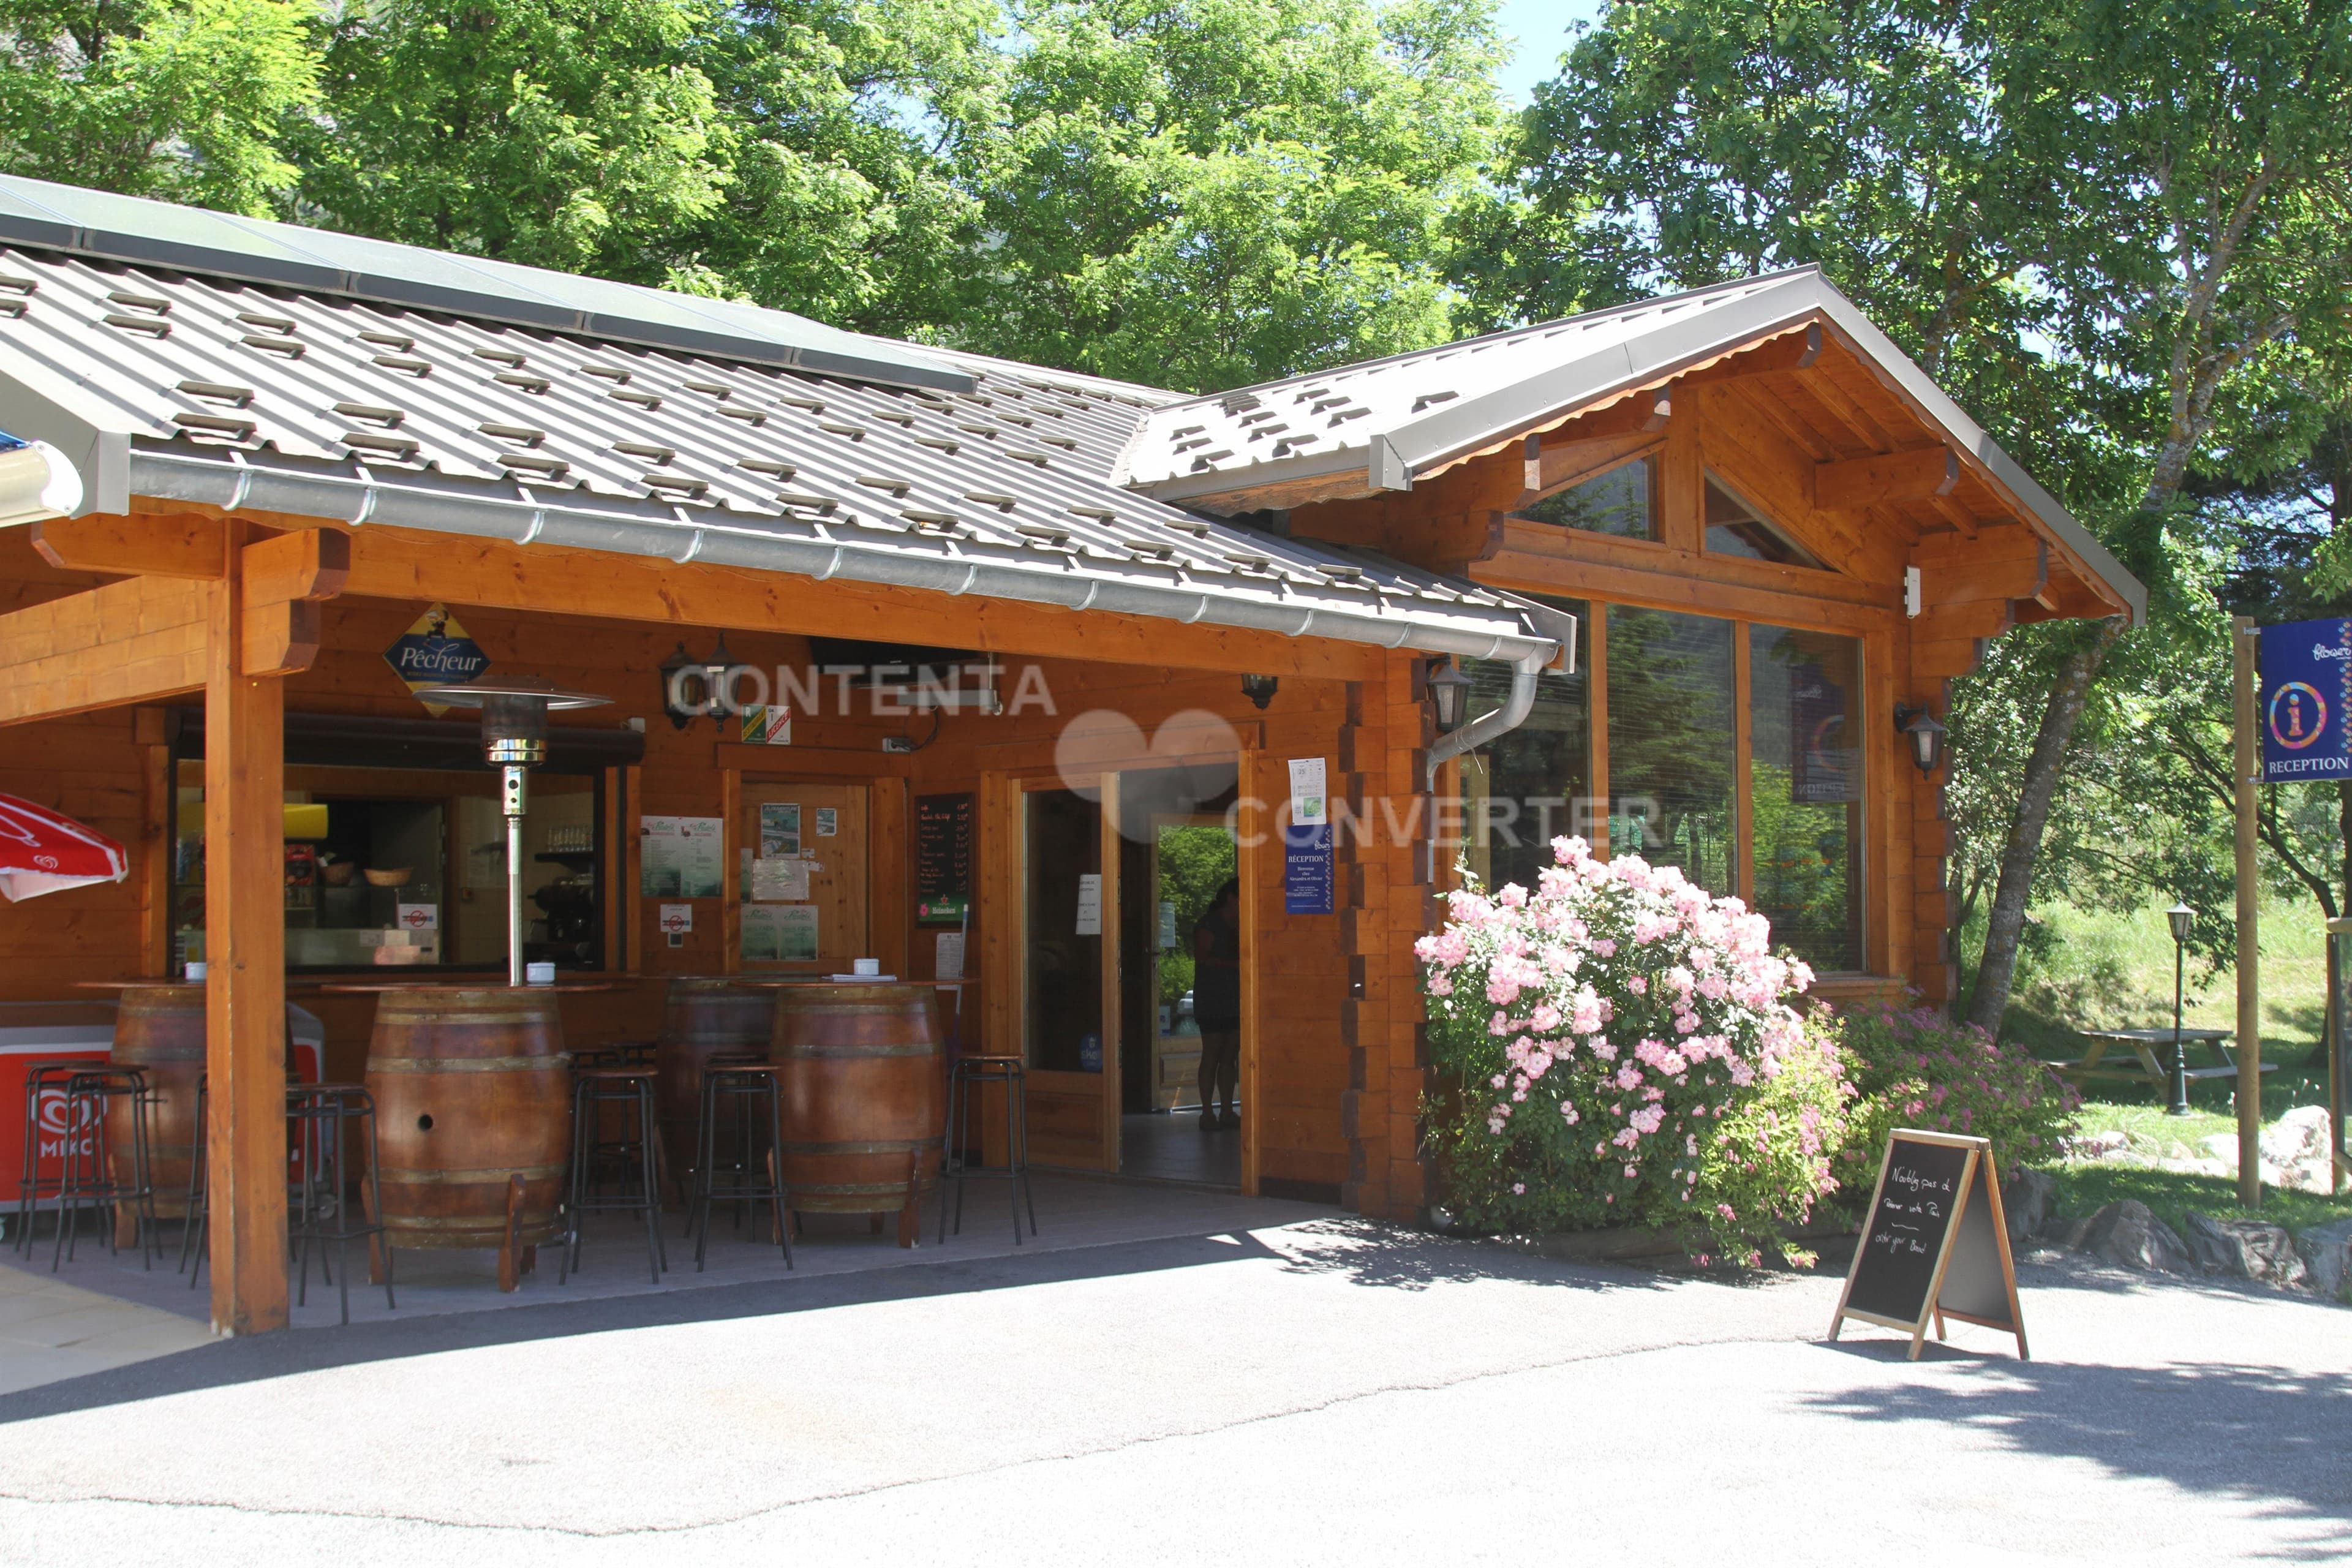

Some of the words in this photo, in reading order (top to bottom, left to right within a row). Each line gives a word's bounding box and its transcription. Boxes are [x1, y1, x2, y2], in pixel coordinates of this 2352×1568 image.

[401, 643, 481, 671] Pêcheur
[745, 706, 751, 717] R
[768, 710, 790, 740] LICENCE
[2269, 757, 2349, 774] RECEPTION
[1288, 854, 1324, 863] RÉCEPTION
[40, 1138, 93, 1158] MIKO
[1921, 1179, 1937, 1190] pas
